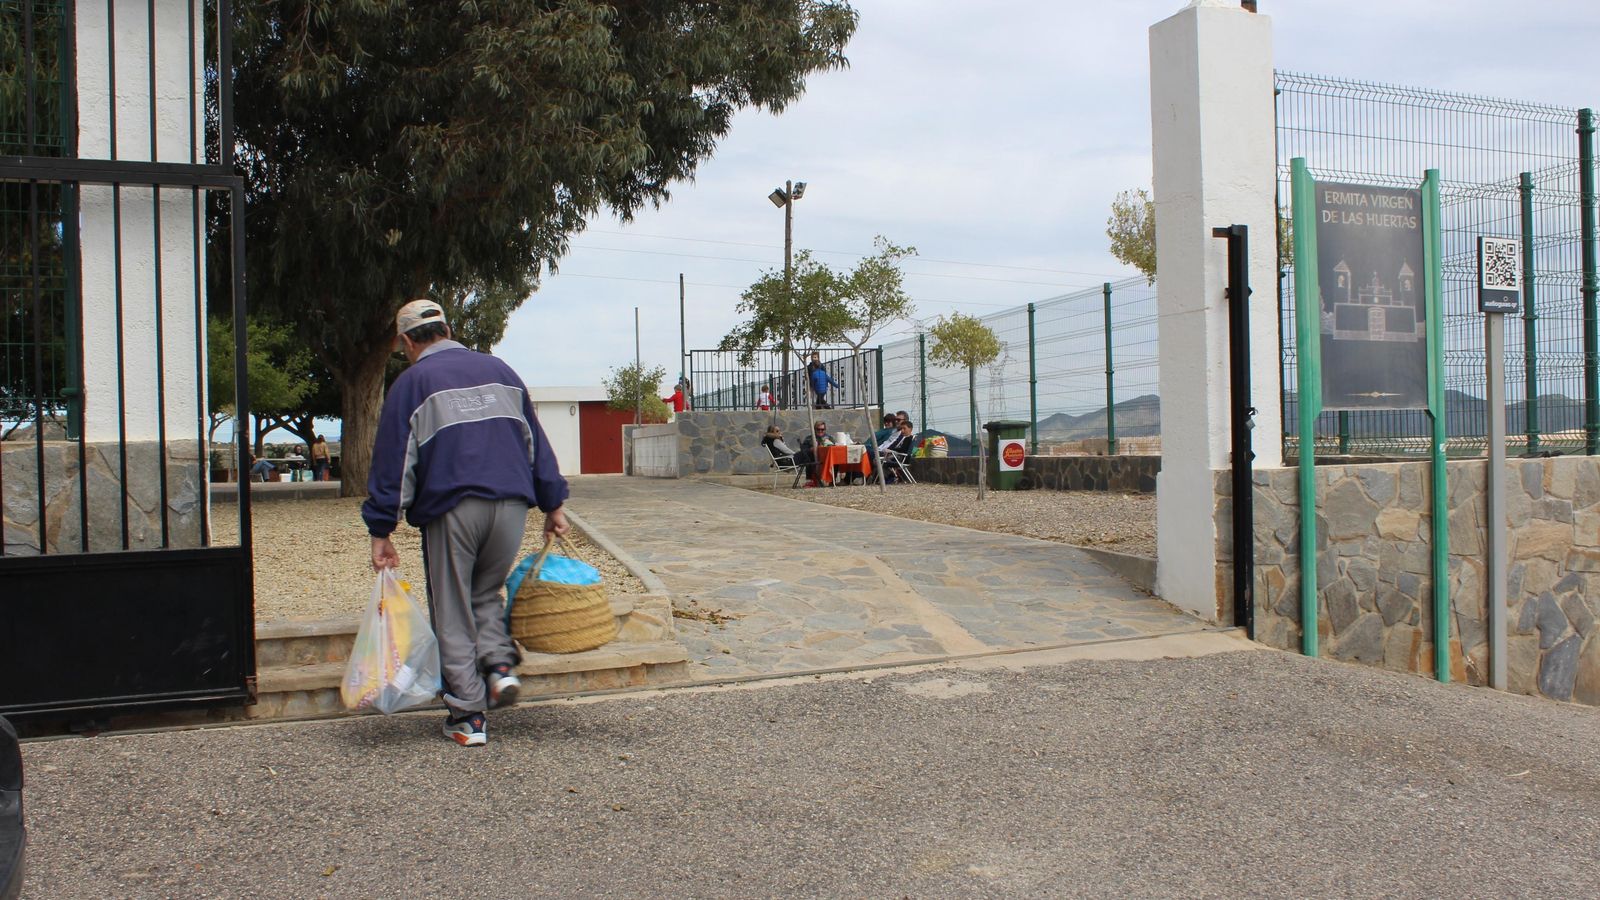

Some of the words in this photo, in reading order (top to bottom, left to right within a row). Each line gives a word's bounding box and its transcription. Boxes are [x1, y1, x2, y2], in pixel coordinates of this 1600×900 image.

[1325, 191, 1368, 207] ERMITA
[1370, 194, 1413, 209] VIRGEN
[1322, 210, 1338, 223] DE
[1342, 212, 1363, 225] LAS
[1366, 213, 1416, 229] HUERTAS
